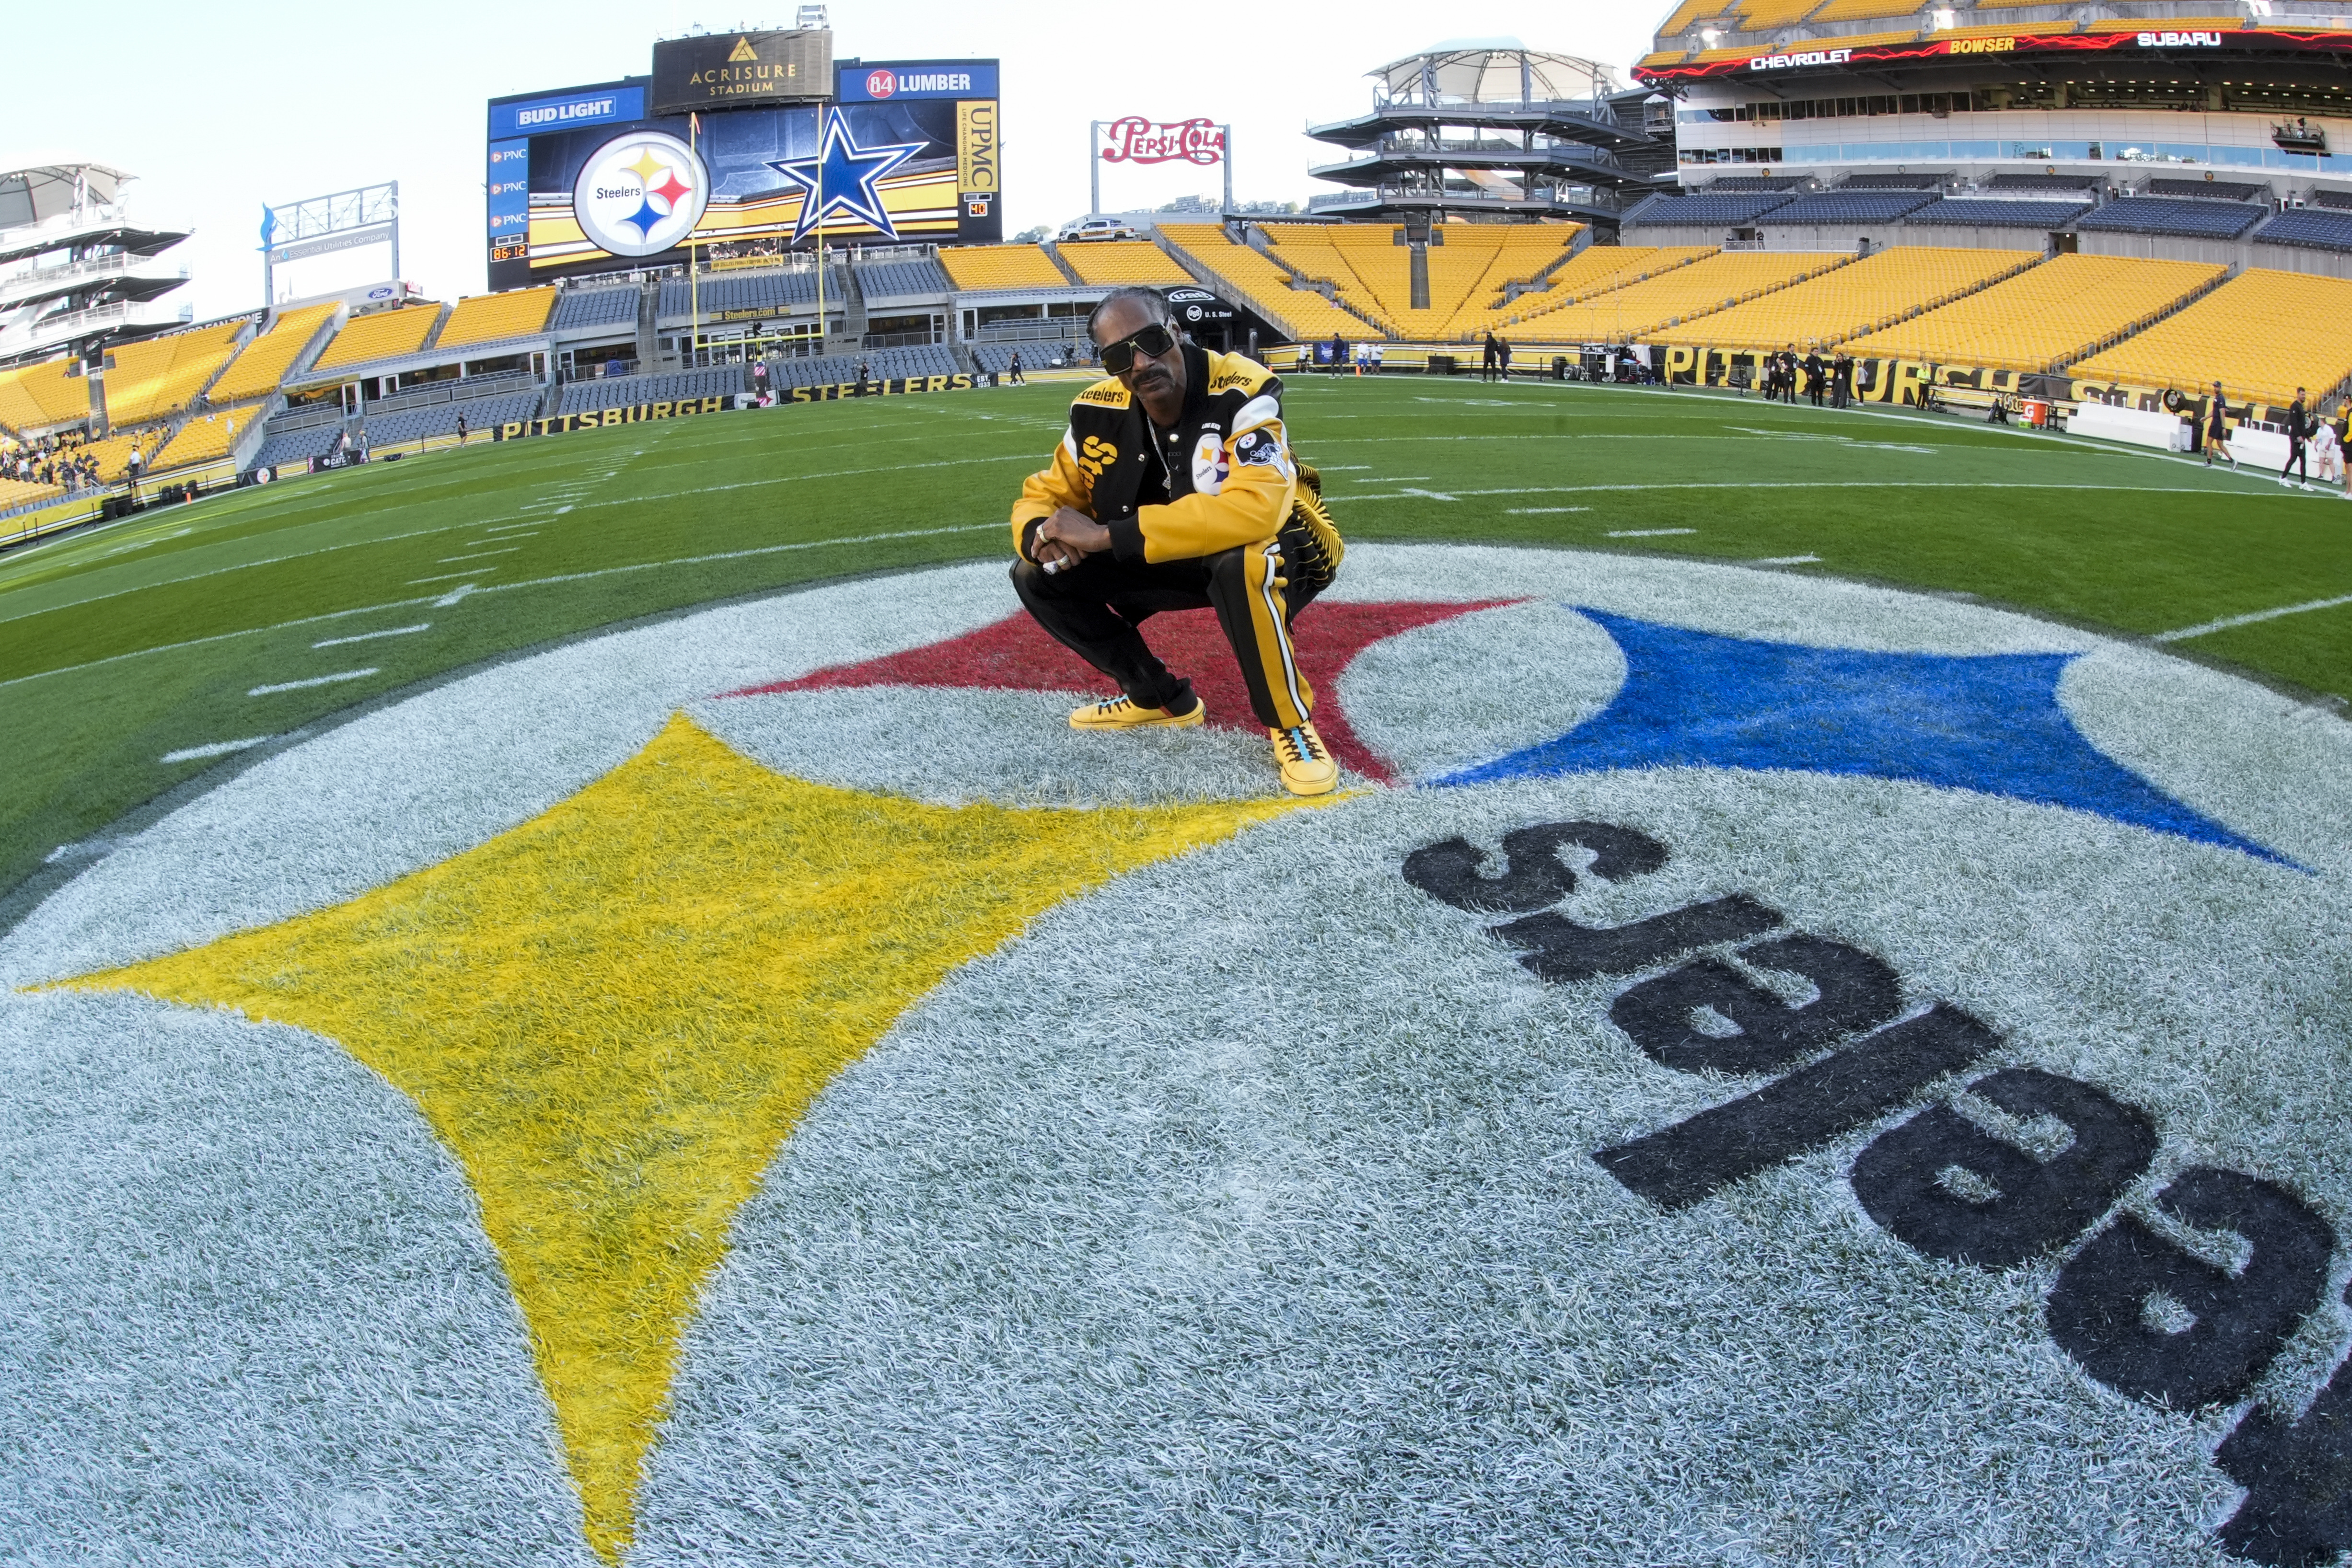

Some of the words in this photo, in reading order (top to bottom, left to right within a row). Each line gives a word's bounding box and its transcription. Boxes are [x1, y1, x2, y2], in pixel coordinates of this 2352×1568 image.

[1949, 37, 2015, 54] BOWSER
[2137, 32, 2221, 46] SUBARU
[1750, 49, 1852, 70] CHEVROLET
[690, 64, 796, 84] ACRISURE
[710, 82, 773, 96] STADIUM
[870, 76, 893, 93] 84
[899, 74, 971, 92] LUMBER
[519, 107, 556, 126] BUD
[559, 100, 612, 120] LIGHT
[971, 106, 993, 187] UPMC
[503, 149, 526, 161] PNC
[503, 181, 526, 193] PNC
[596, 187, 641, 199] Steelers
[971, 204, 985, 214] 40
[282, 196, 399, 242] PEOPLES
[503, 213, 526, 225] PNC
[290, 244, 322, 258] Essential
[324, 239, 352, 251] Utilities
[354, 231, 390, 244] Company
[494, 245, 525, 260] 86:12
[372, 289, 389, 298] Ford
[725, 309, 776, 320] Steelers.com
[793, 373, 973, 404] STEELERS
[2024, 405, 2034, 417] G
[502, 396, 722, 441] PITTSBURGH
[331, 455, 350, 465] CATC
[1196, 466, 1212, 480] Steelers
[1401, 819, 2352, 1568] teelers
